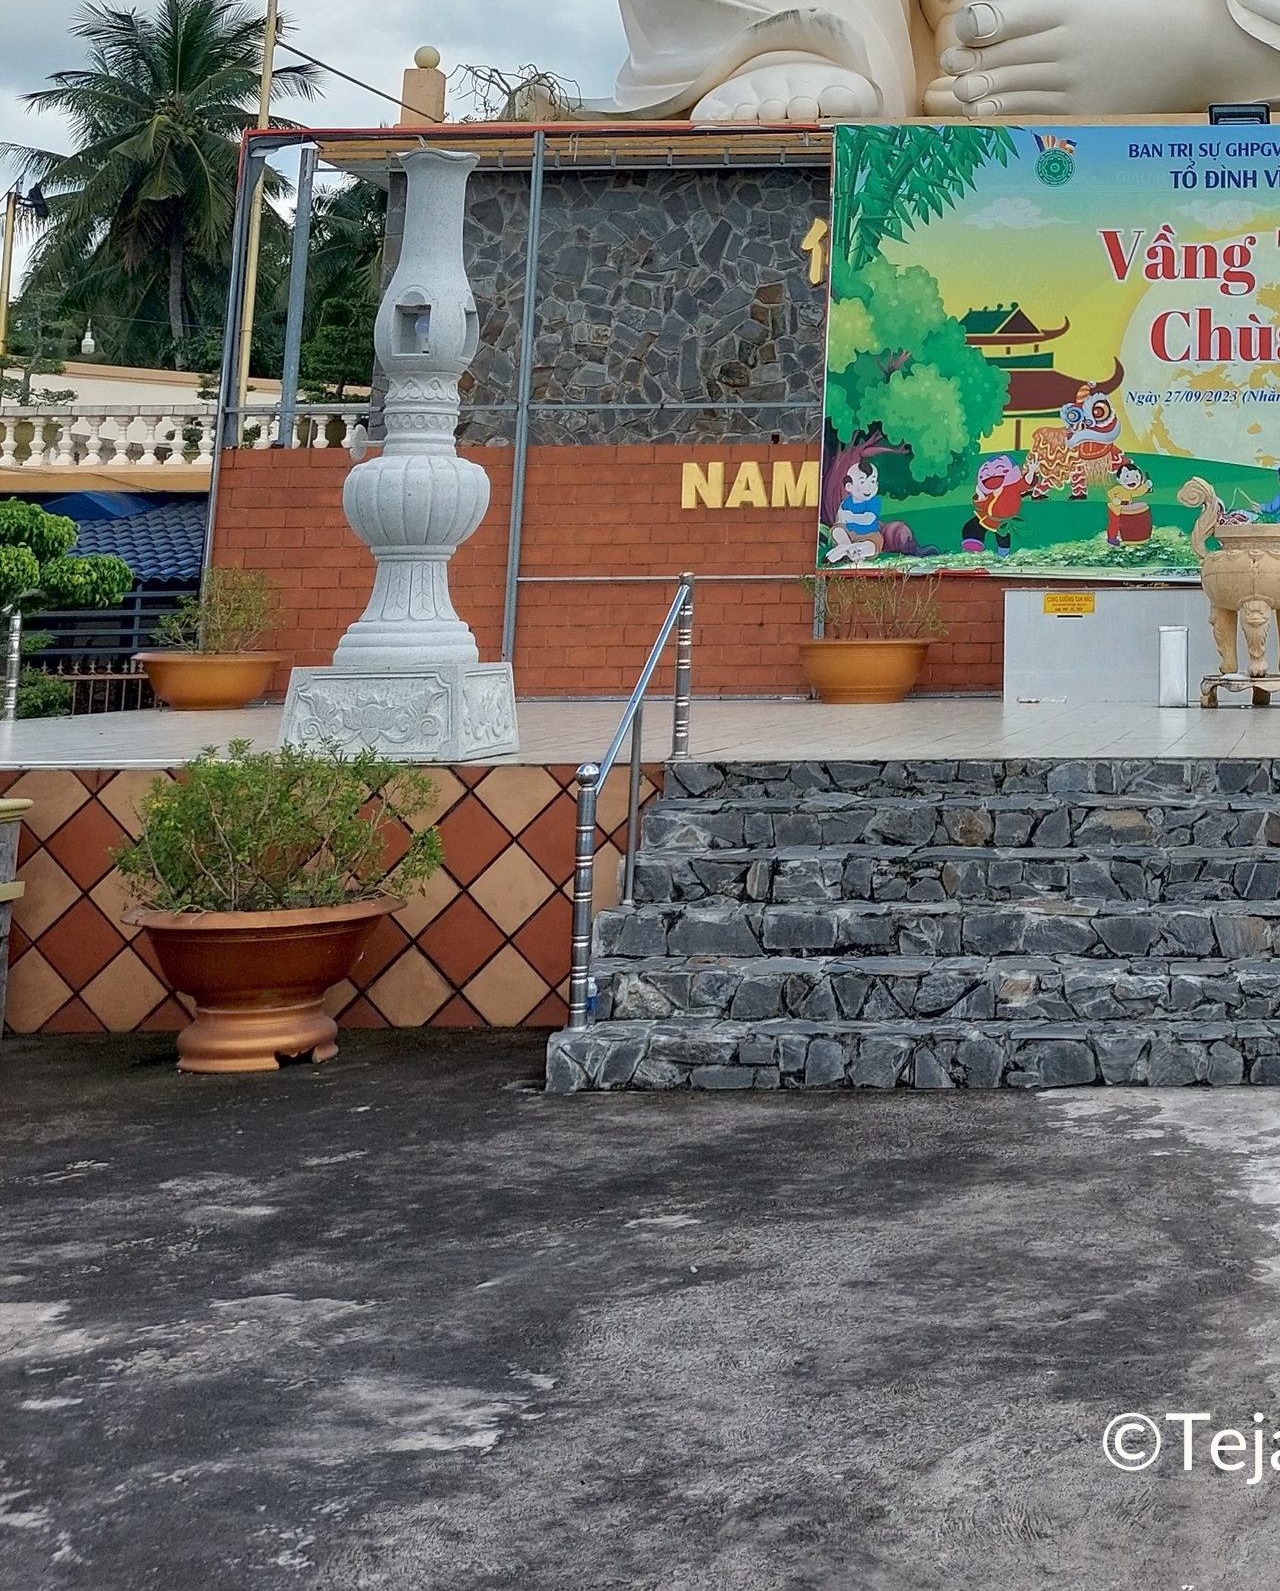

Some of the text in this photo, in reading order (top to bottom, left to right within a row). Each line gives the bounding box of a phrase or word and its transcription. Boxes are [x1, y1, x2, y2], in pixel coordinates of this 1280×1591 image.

[1128, 143, 1163, 158] BAN
[1168, 143, 1193, 160] TRỊ
[1198, 141, 1221, 161] SỰ
[1170, 160, 1197, 189] TỔ
[1205, 165, 1257, 189] ĐÌNH
[1099, 224, 1257, 296] Vầng
[1126, 390, 1160, 405] Ngày
[1164, 390, 1238, 403] 27/09/2023
[681, 461, 820, 508] NAM
